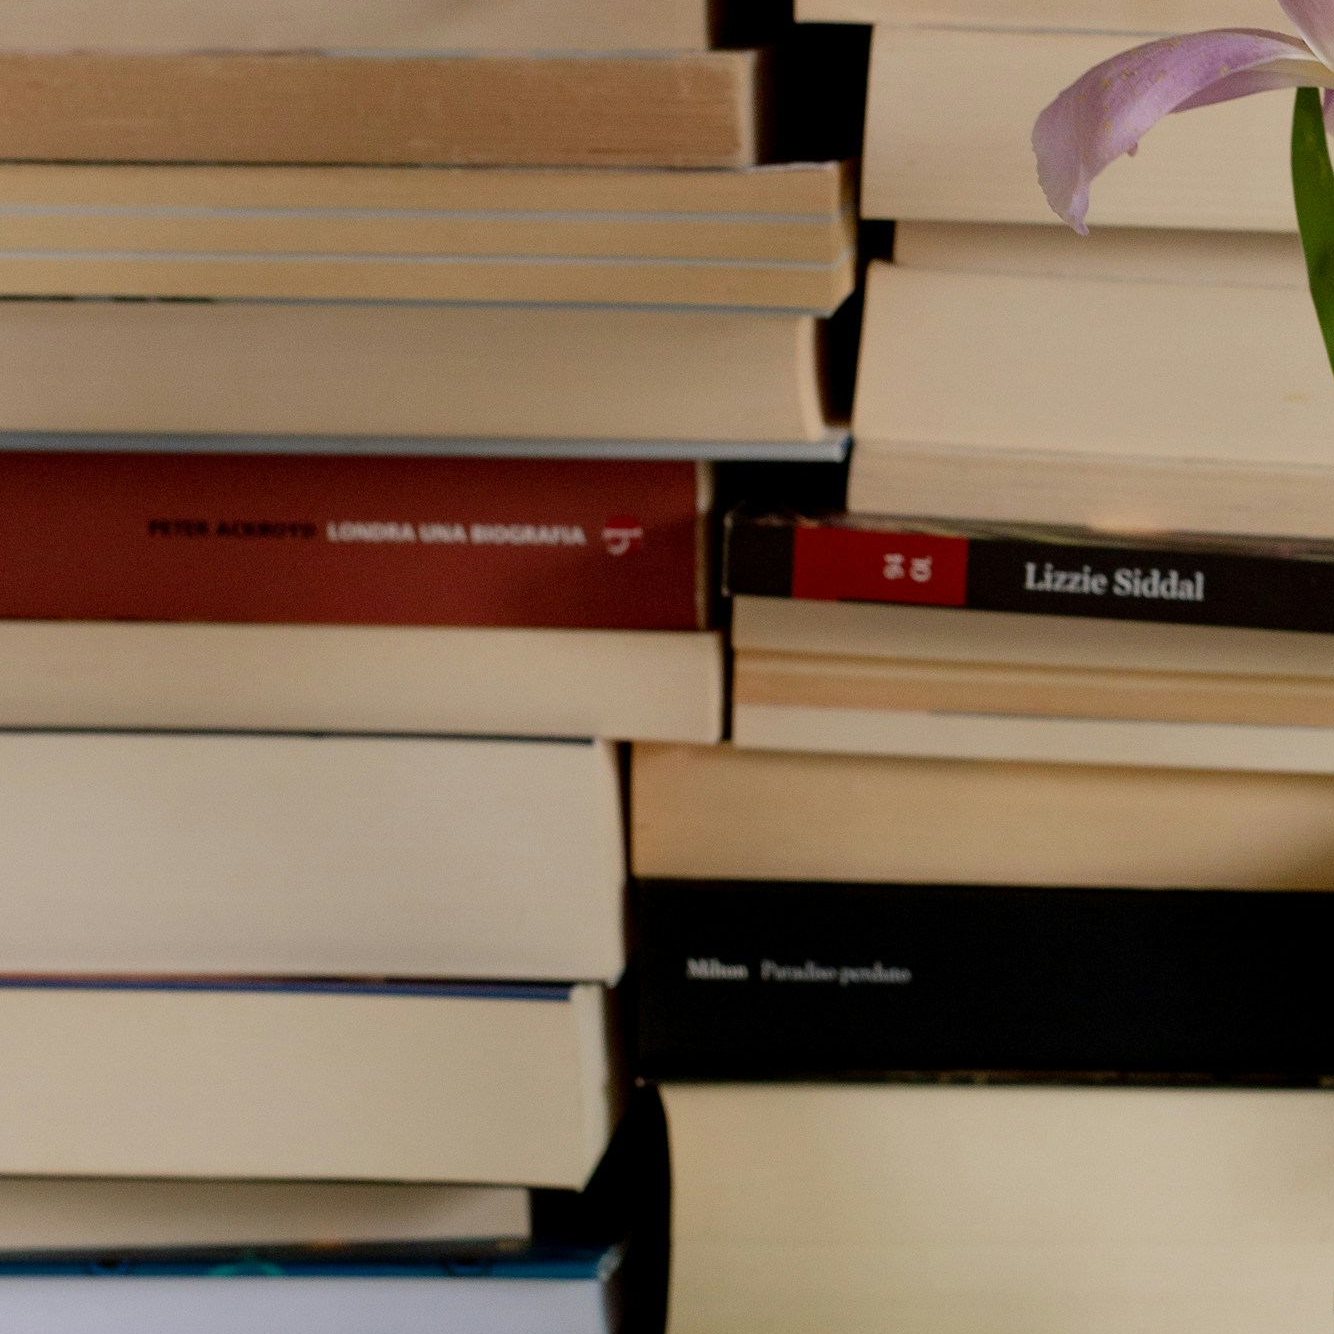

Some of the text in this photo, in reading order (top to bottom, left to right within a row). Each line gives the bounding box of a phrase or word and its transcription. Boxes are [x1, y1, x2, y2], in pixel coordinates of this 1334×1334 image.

[325, 521, 587, 547] LONDRA UNA BIOGRAFIA
[1024, 560, 1206, 603] Lizzie Siddal
